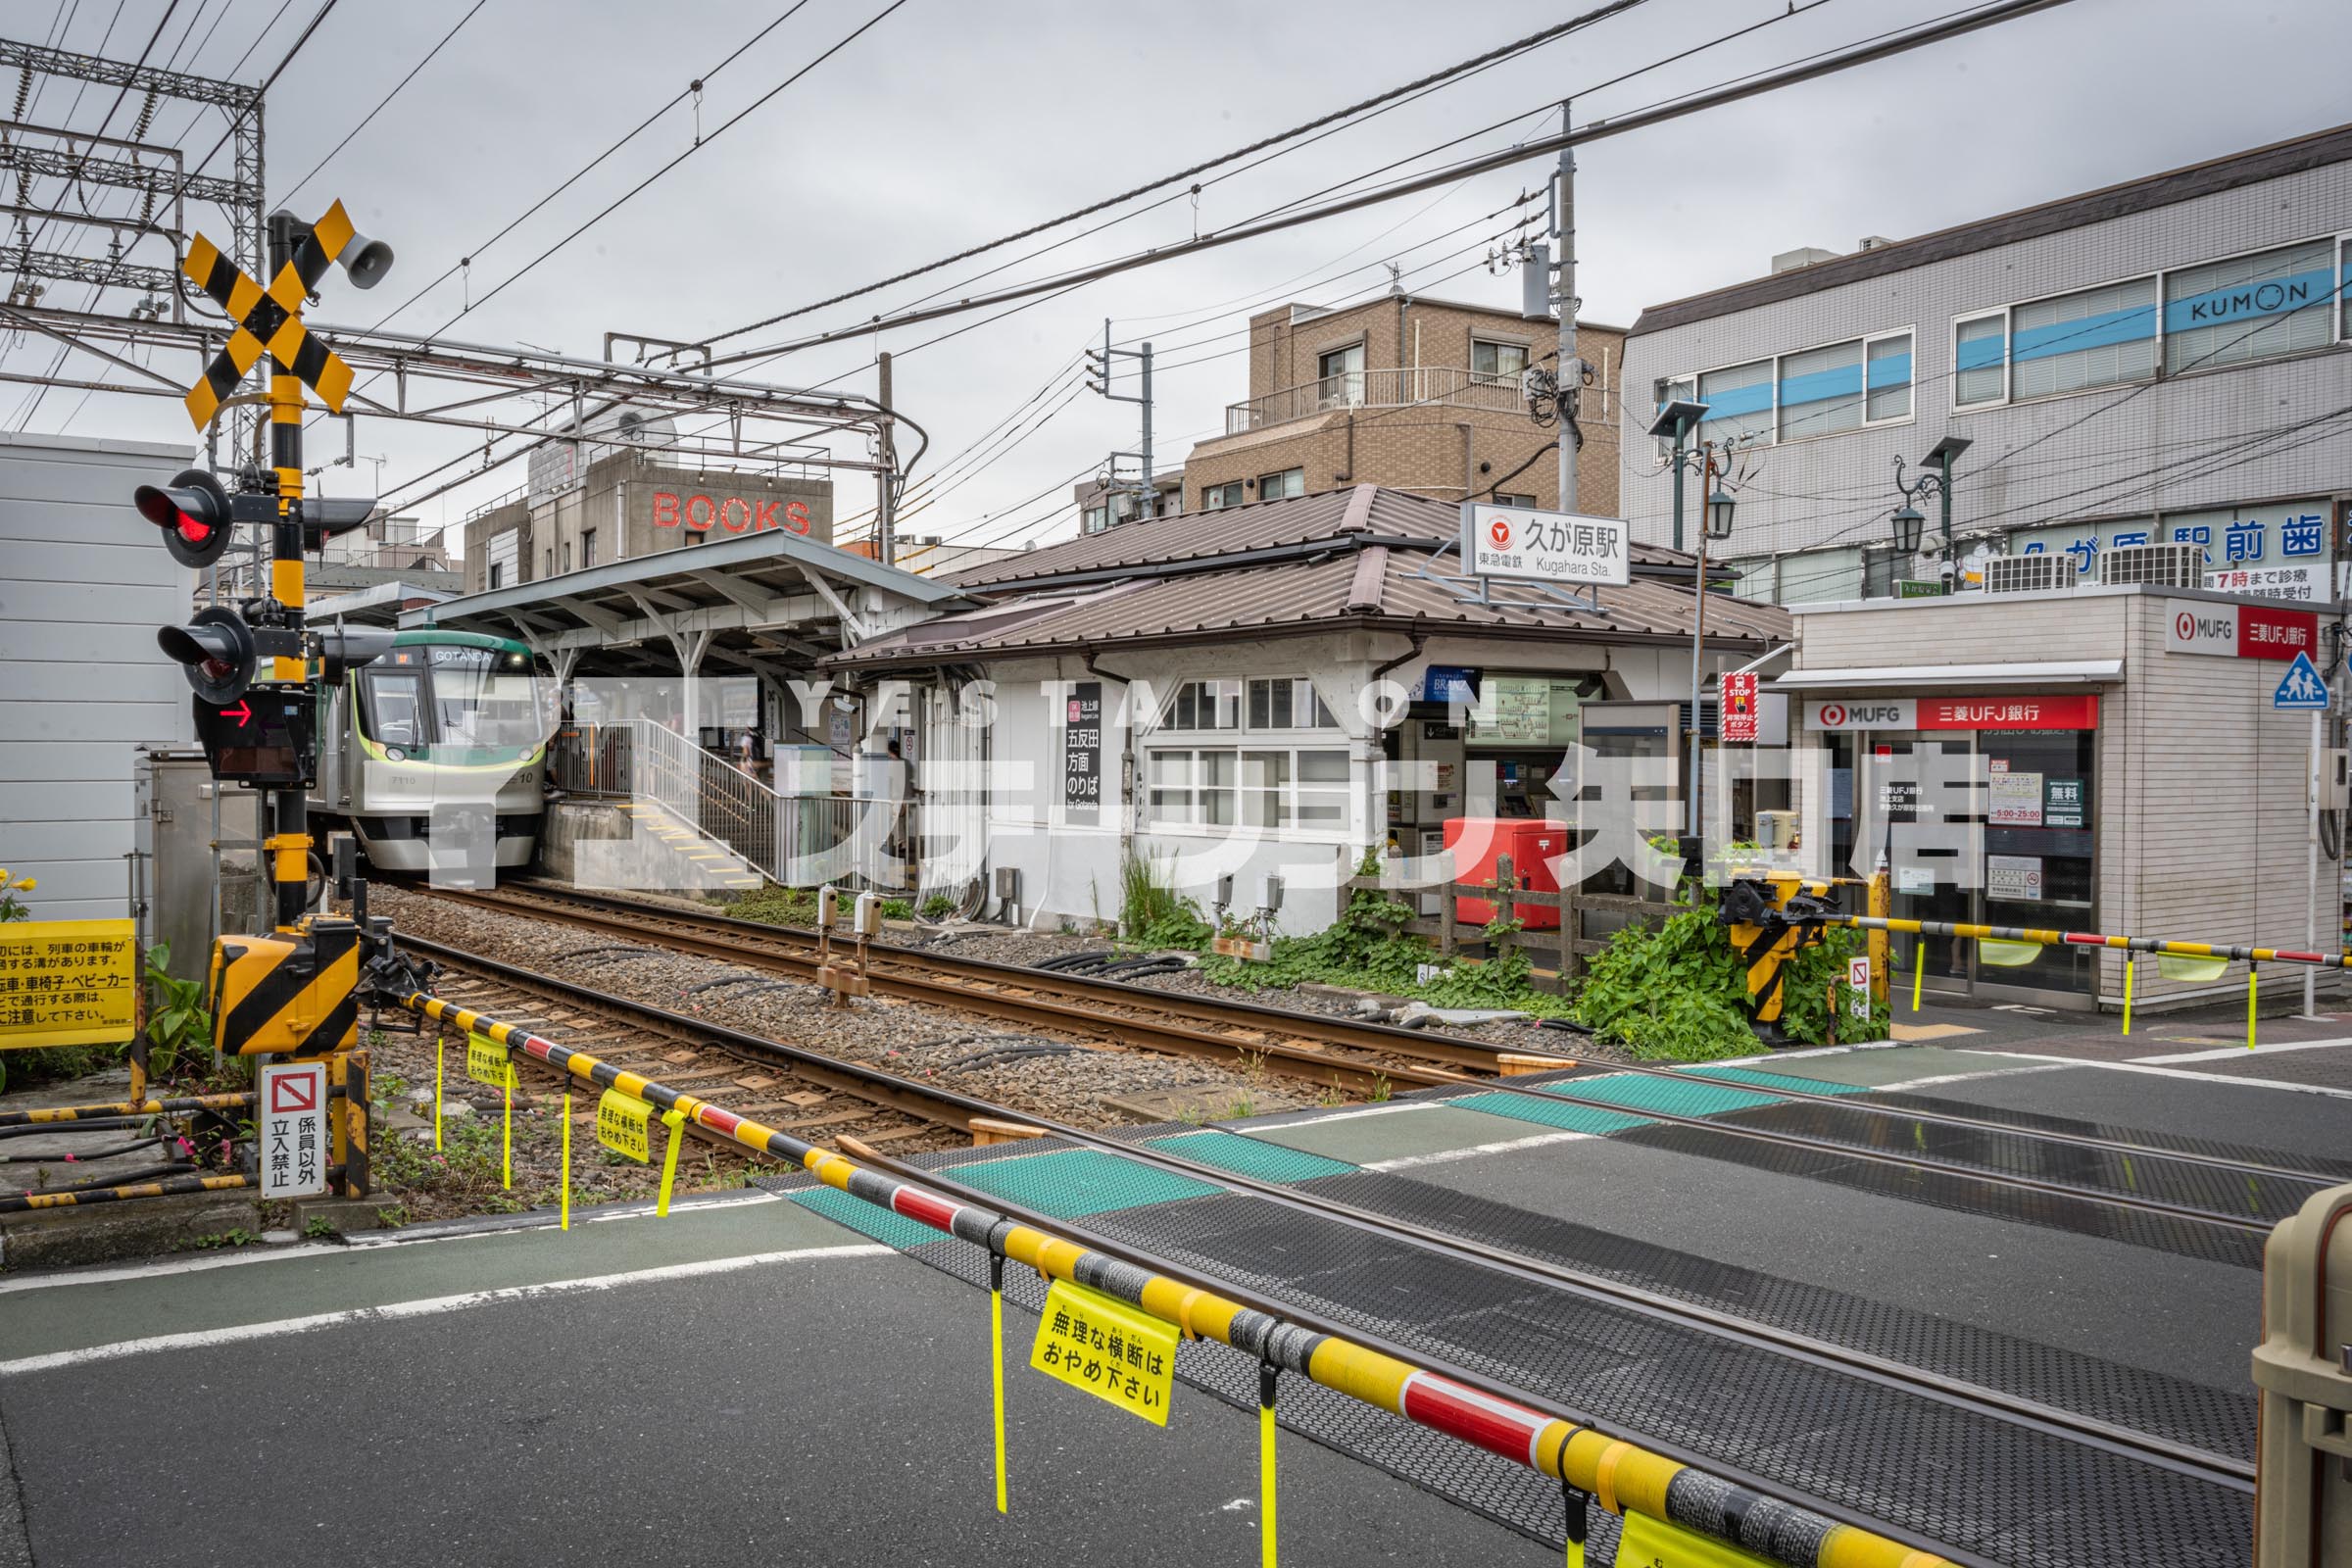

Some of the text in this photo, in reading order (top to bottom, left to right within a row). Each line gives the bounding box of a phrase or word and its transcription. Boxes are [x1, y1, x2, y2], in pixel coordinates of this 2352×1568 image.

[2191, 281, 2308, 321] KUMON
[653, 491, 810, 537] BOOKS
[1525, 518, 1618, 559] 久が原駅
[1479, 552, 1523, 568] 東急電鉄
[1537, 557, 1611, 577] Kugahara Sta.
[2197, 618, 2232, 640] MUFG
[2248, 622, 2307, 646] 三菱UFJ銀行
[435, 651, 492, 662] GOTANDA
[1848, 706, 1900, 723] MUFG
[1938, 703, 2039, 722] 三菱UFJ銀行
[1068, 728, 1100, 748] 五反田
[1067, 752, 1089, 772] 方面
[519, 772, 533, 784] 10
[1067, 776, 1099, 795] のりば
[2050, 787, 2079, 801] 無料
[1075, 799, 1099, 810] Gotanda
[601, 1127, 645, 1152] おやめ下さい
[270, 1118, 290, 1189] 立入禁止
[298, 1115, 317, 1186] 係員以外
[1051, 1310, 1164, 1377] 無理な横断は
[1043, 1341, 1160, 1408] おやめ下さい
